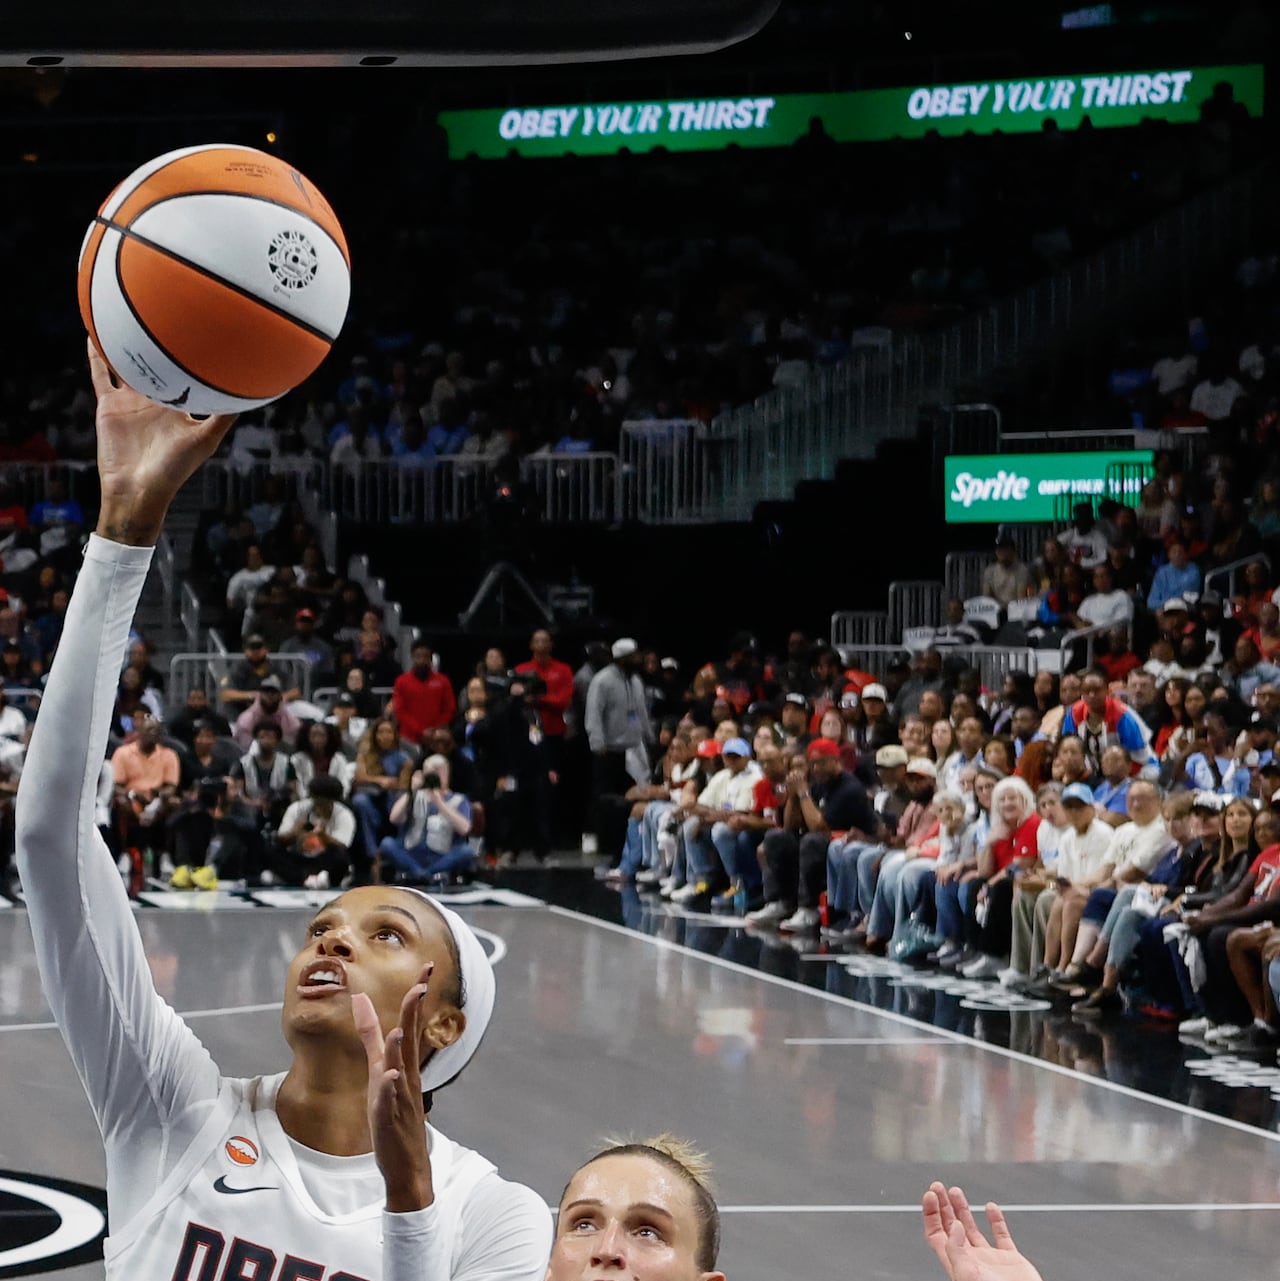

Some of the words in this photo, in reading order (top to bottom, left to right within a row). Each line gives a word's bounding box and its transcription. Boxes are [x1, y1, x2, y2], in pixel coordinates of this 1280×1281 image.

[907, 84, 989, 118] OBEY
[991, 79, 1076, 112] YOUR
[1081, 71, 1193, 108] THIRST
[498, 106, 579, 139] OBEY
[581, 103, 663, 136] YOUR
[667, 97, 776, 132] THIRST
[951, 470, 1031, 508] Sprite
